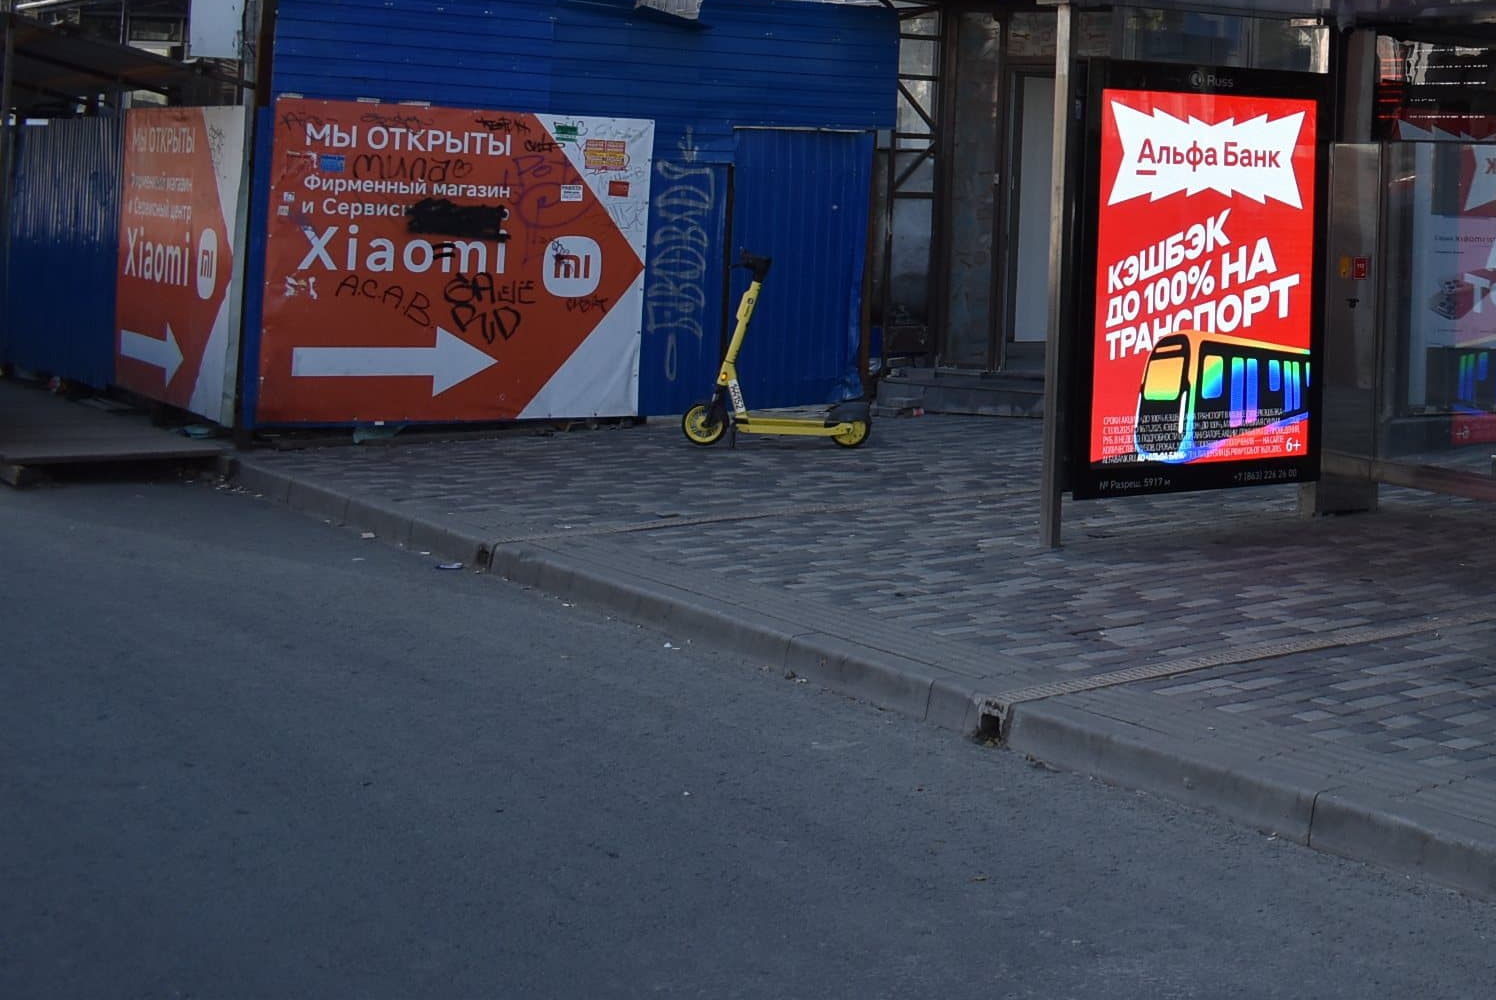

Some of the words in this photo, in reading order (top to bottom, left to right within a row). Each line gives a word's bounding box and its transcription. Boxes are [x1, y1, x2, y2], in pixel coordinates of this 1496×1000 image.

[1207, 74, 1234, 89] Russ
[149, 127, 196, 154] ОТКРЫТЫ
[305, 123, 358, 148] МЫ
[367, 125, 512, 157] ОТКРЫТЫ
[1136, 138, 1219, 174] Альфа
[1223, 141, 1282, 169] Банк
[304, 175, 427, 197] Фирменный
[433, 184, 511, 199] магазин
[302, 201, 314, 213] и
[124, 226, 191, 287] Xiaomi
[297, 225, 508, 275] Xiaomi
[1107, 208, 1232, 294] КЭШБЭК
[1105, 290, 1142, 328] ДО
[1143, 259, 1216, 313] 100%
[1221, 236, 1278, 290] НА
[1105, 273, 1301, 361] ТРАНСПОРТ
[1285, 437, 1302, 452] 6+
[1144, 477, 1163, 488] 5917
